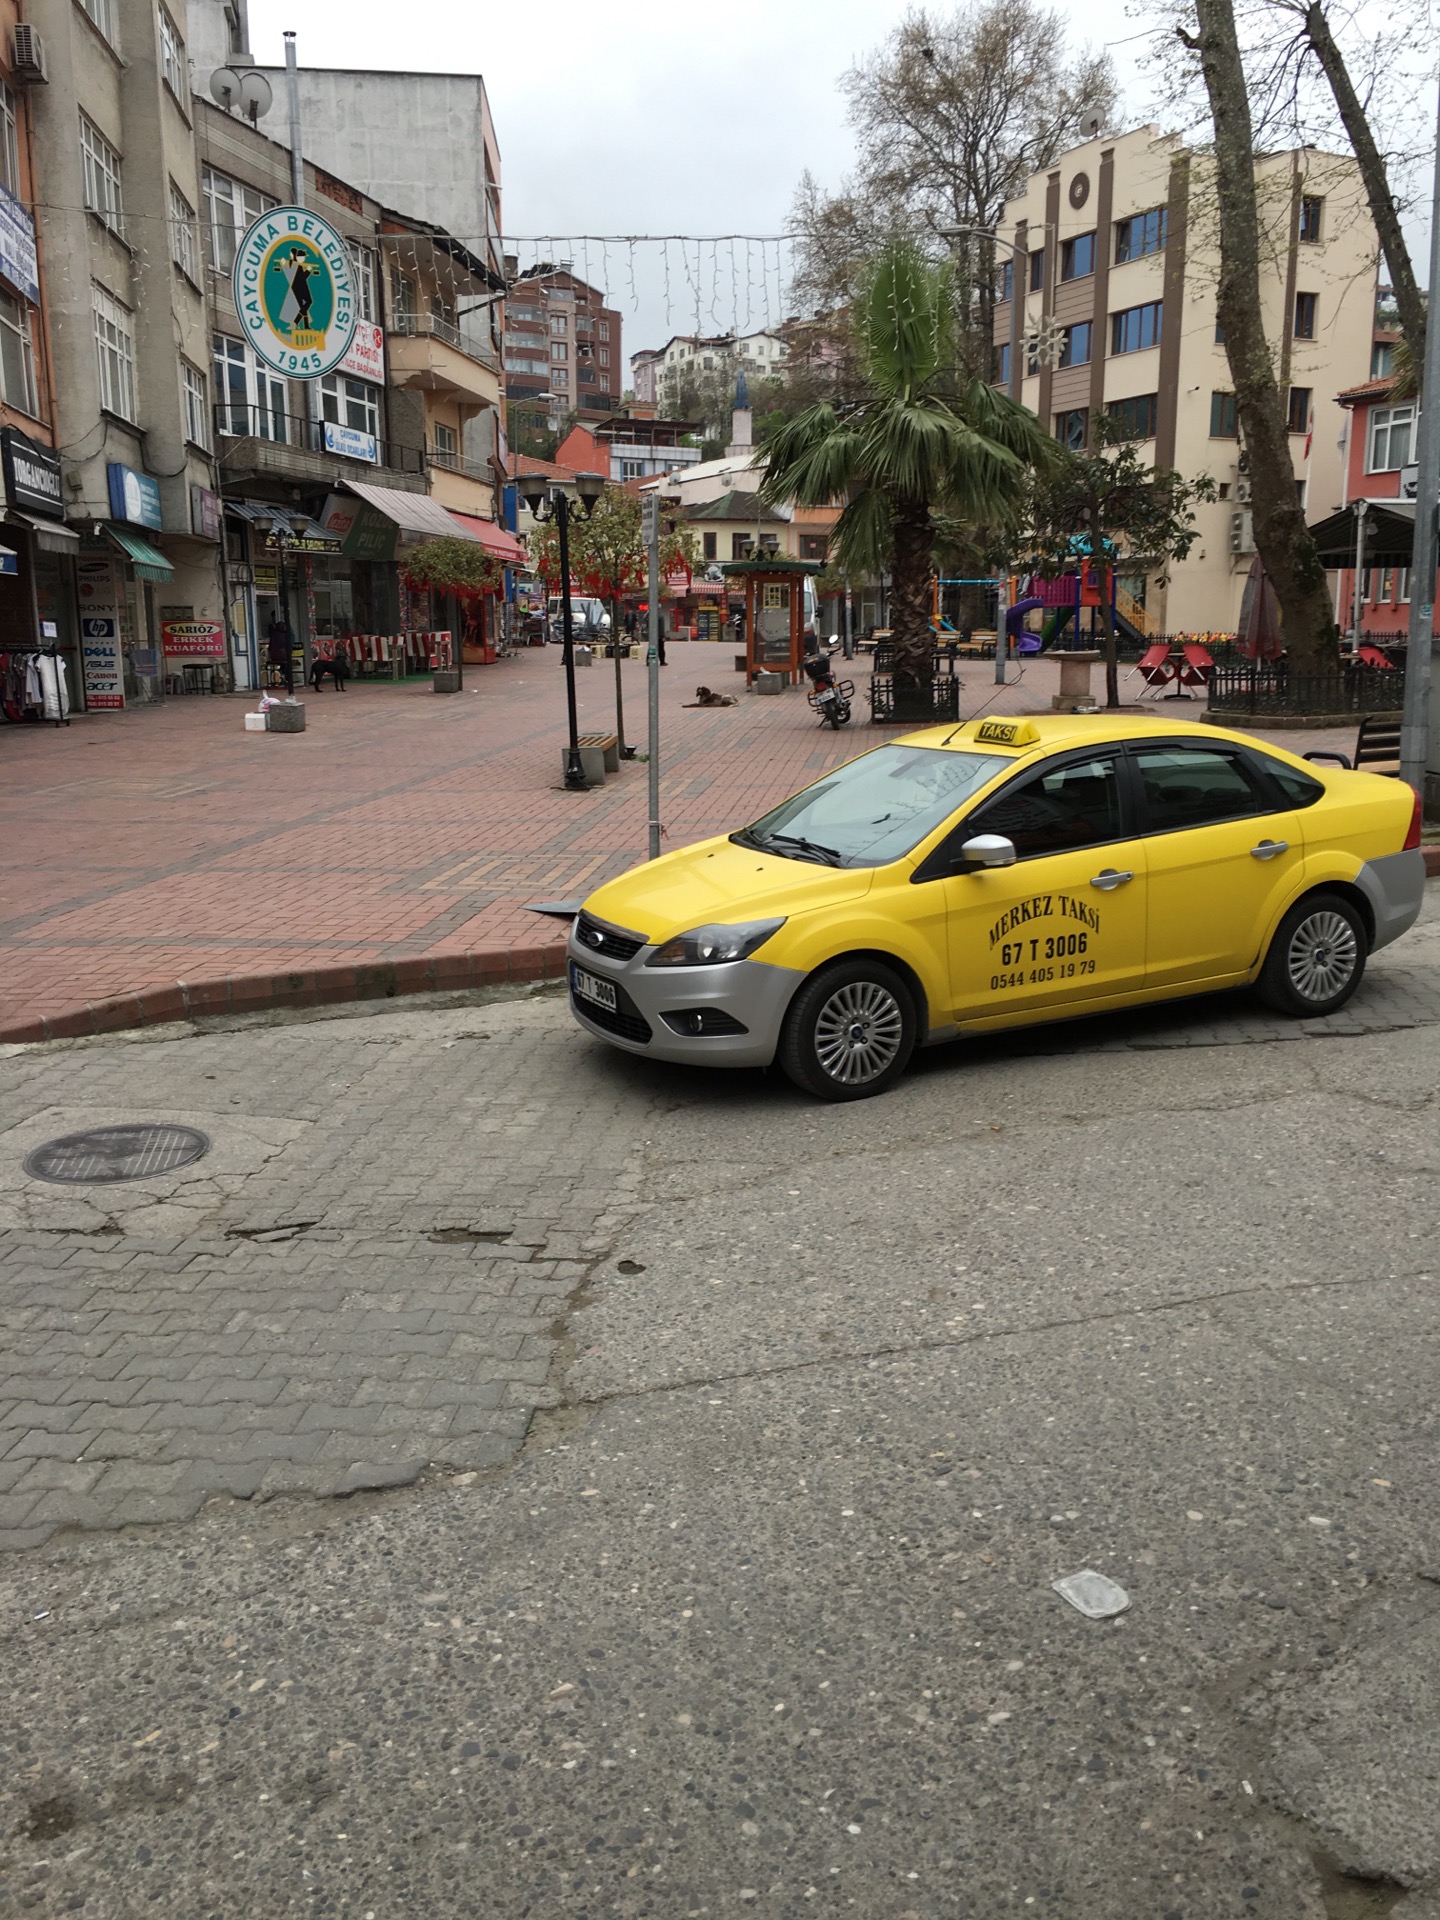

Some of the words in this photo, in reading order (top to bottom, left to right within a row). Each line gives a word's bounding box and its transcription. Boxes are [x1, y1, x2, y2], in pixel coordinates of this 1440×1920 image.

[243, 223, 280, 330] ÇAYCUMA
[287, 215, 351, 333] BELEDİYESİ
[278, 350, 322, 371] 1945
[79, 575, 111, 583] PHILIPS
[80, 604, 115, 612] SONY
[170, 624, 214, 634] SARIÖZ
[83, 647, 116, 657] DELL
[164, 643, 223, 652] KUAFÖRÜ
[85, 660, 115, 668] ASUS
[86, 671, 118, 680] Canon
[86, 682, 118, 691] acer
[989, 895, 1054, 952] MERKEZ
[1002, 942, 1023, 967] 67
[1029, 938, 1039, 962] T
[1044, 932, 1088, 960] 3006
[990, 971, 1025, 991] 0544
[1029, 966, 1054, 984] 405
[1059, 963, 1075, 979] 19
[1080, 959, 1096, 975] 79
[586, 976, 592, 994] T
